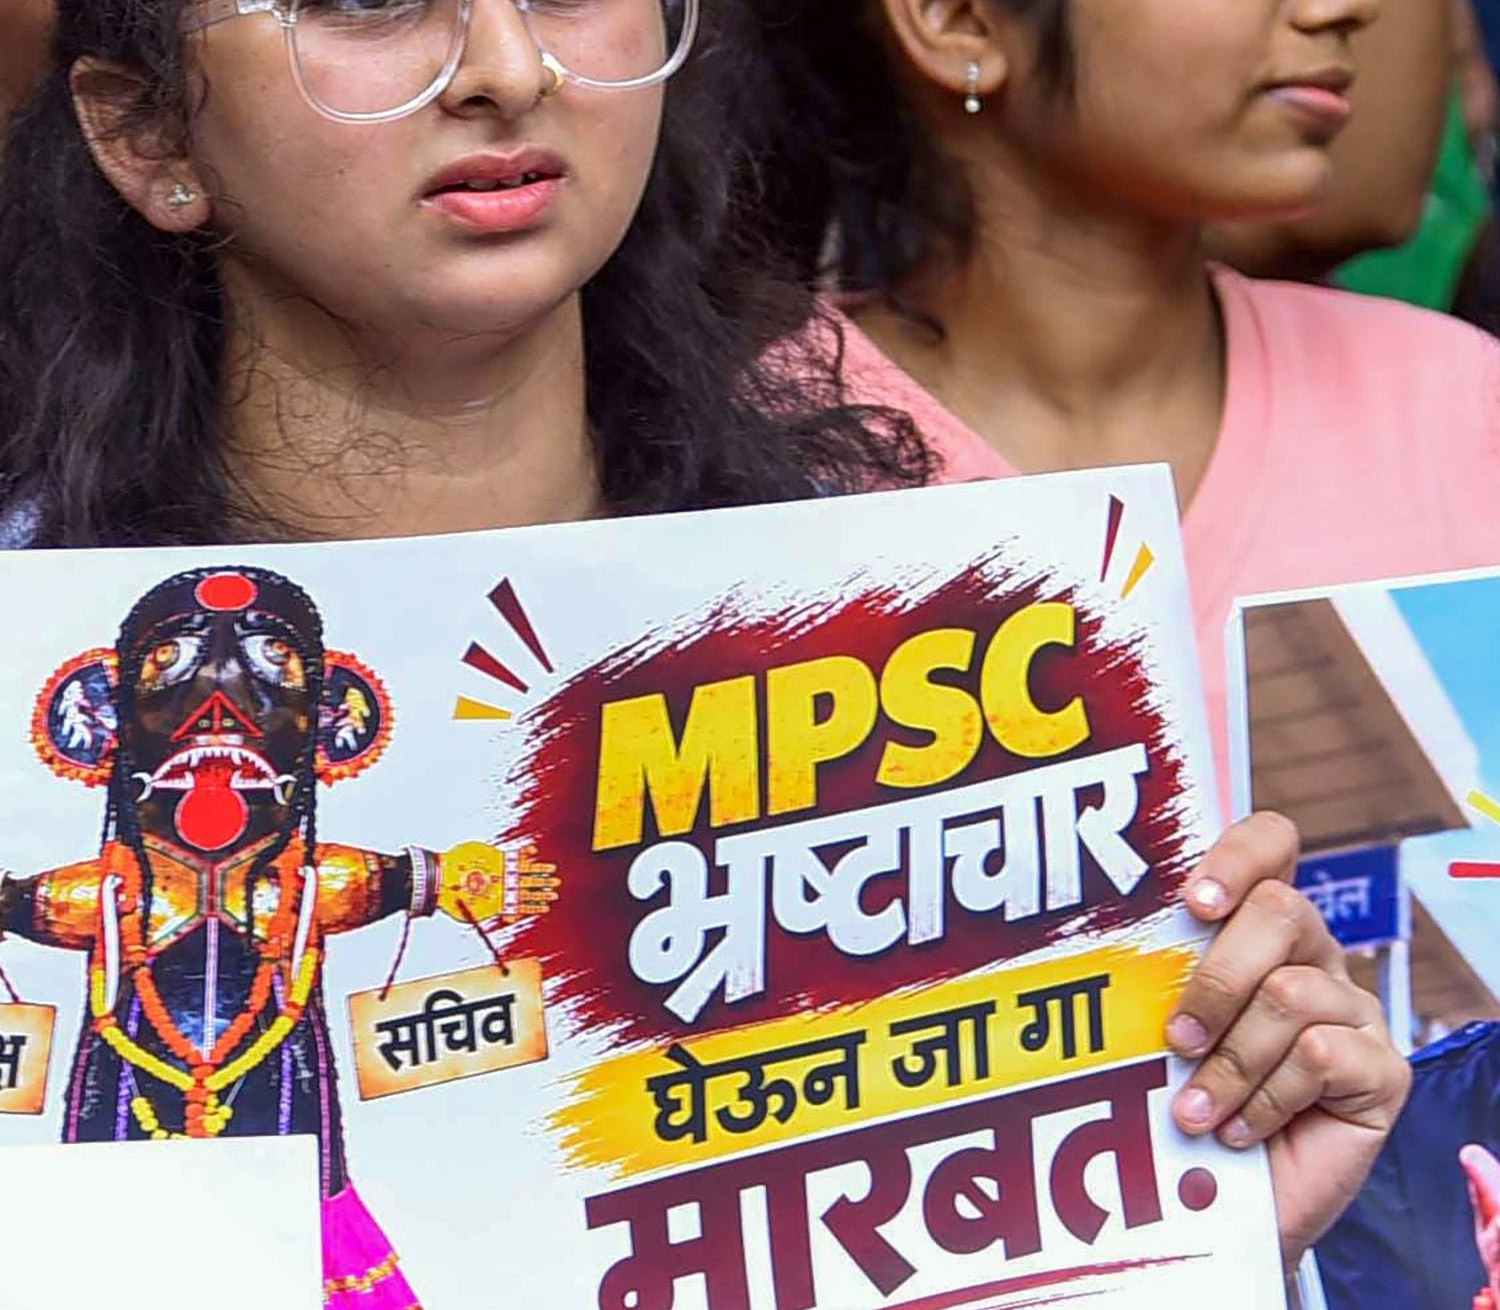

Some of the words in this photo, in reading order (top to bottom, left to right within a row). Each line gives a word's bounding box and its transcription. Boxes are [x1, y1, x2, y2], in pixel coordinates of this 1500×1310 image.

[592, 602, 1092, 852] MPSC
[630, 743, 1150, 1025] भ्रष्टाचार
[377, 990, 516, 1072] सचिव
[645, 1030, 868, 1146] घेऊन
[888, 998, 996, 1092] जा
[1016, 972, 1112, 1058] गा
